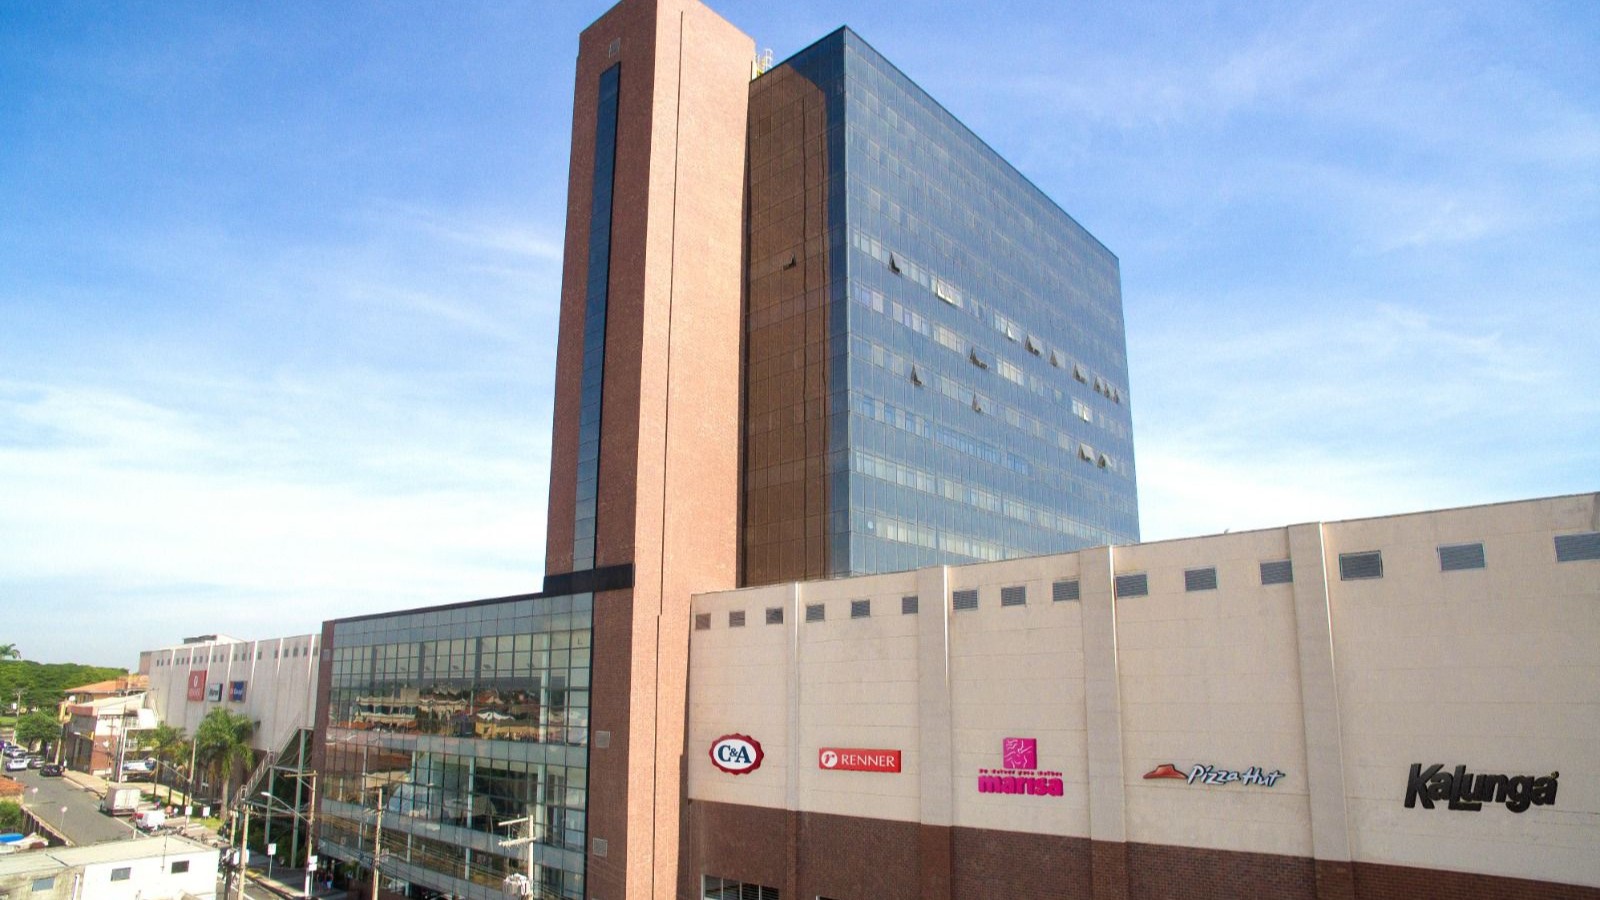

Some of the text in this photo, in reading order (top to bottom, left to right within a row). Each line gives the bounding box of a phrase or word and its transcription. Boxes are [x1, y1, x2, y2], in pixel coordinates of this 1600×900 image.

[718, 744, 752, 764] C&A
[841, 754, 896, 767] RENNER
[1187, 763, 1286, 787] Pizza Hut
[978, 775, 1064, 797] marisa
